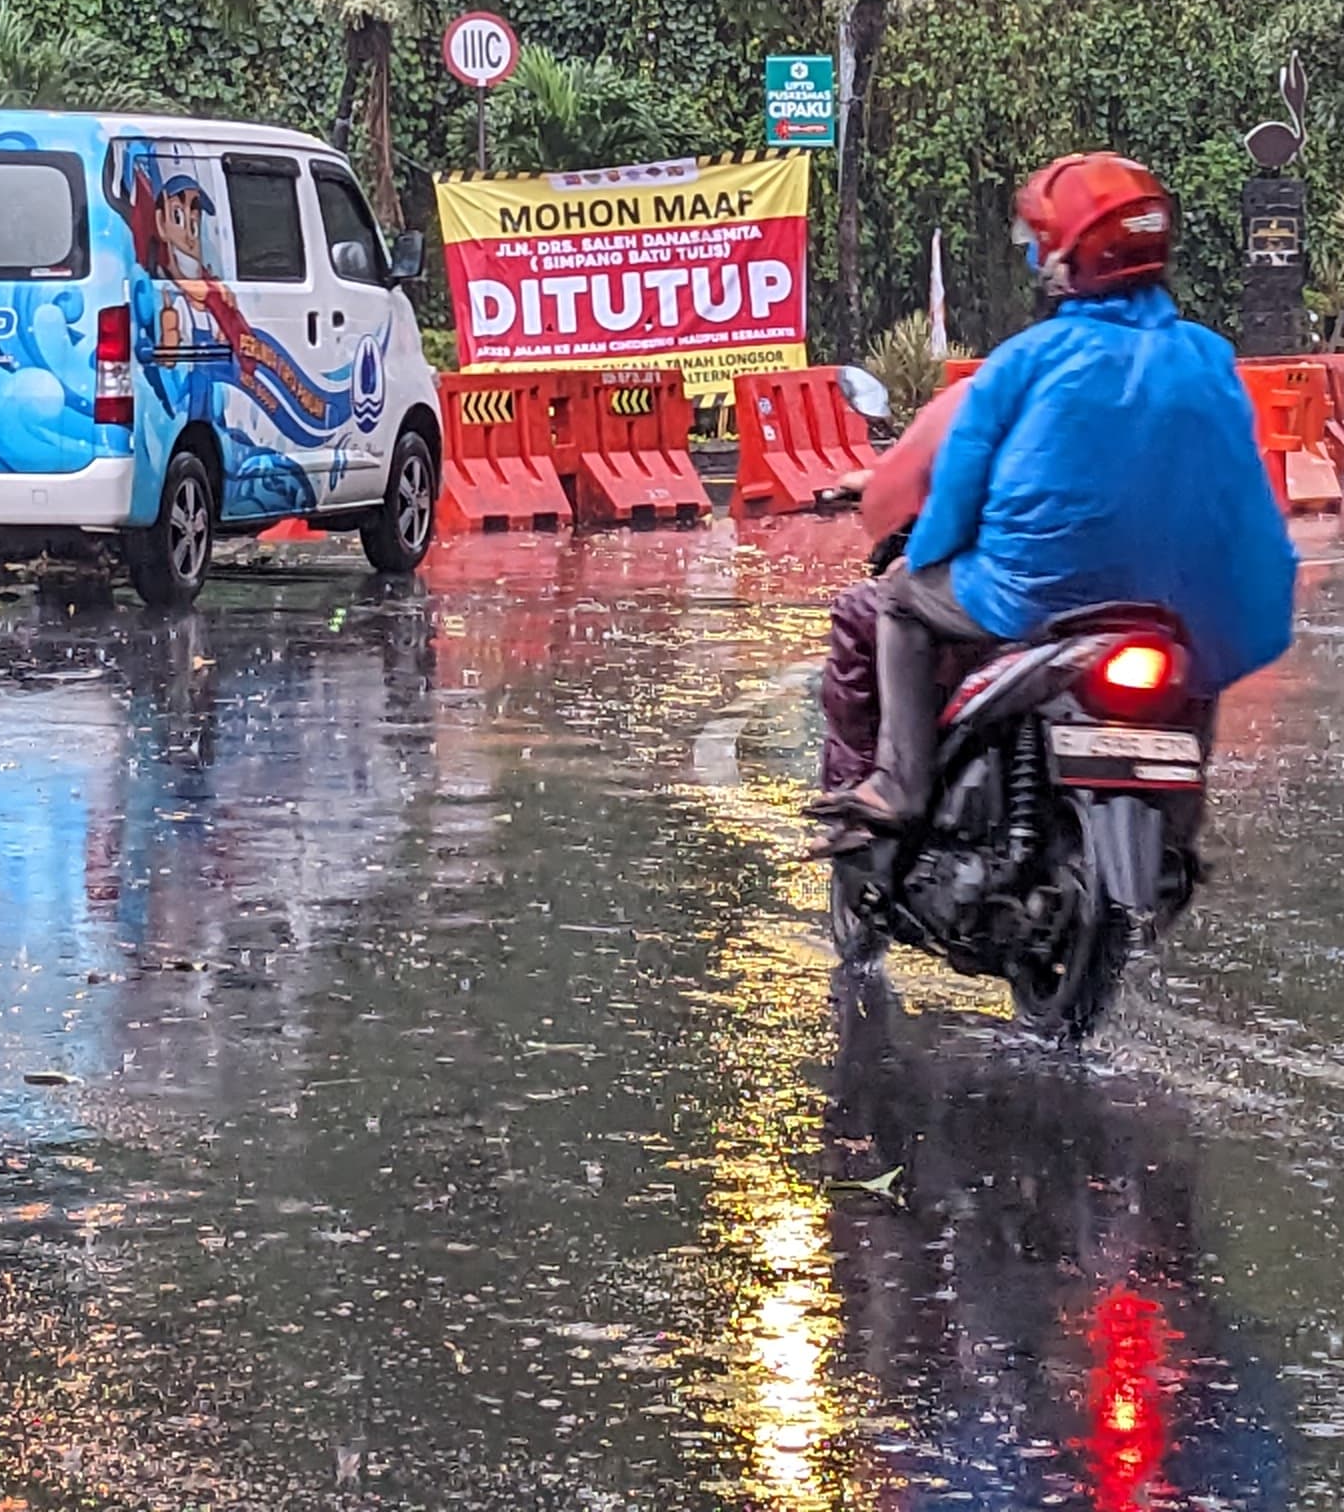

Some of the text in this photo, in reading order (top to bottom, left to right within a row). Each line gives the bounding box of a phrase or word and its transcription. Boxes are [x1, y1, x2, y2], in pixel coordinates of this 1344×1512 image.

[768, 101, 832, 119] CIPAKU
[499, 189, 754, 234] MOHON MAAF
[582, 235, 638, 252] SALEH
[543, 254, 623, 271] SIMPANG
[628, 246, 671, 264] BATU
[467, 259, 793, 338] DITUTUP
[718, 350, 785, 367] LONGSOR
